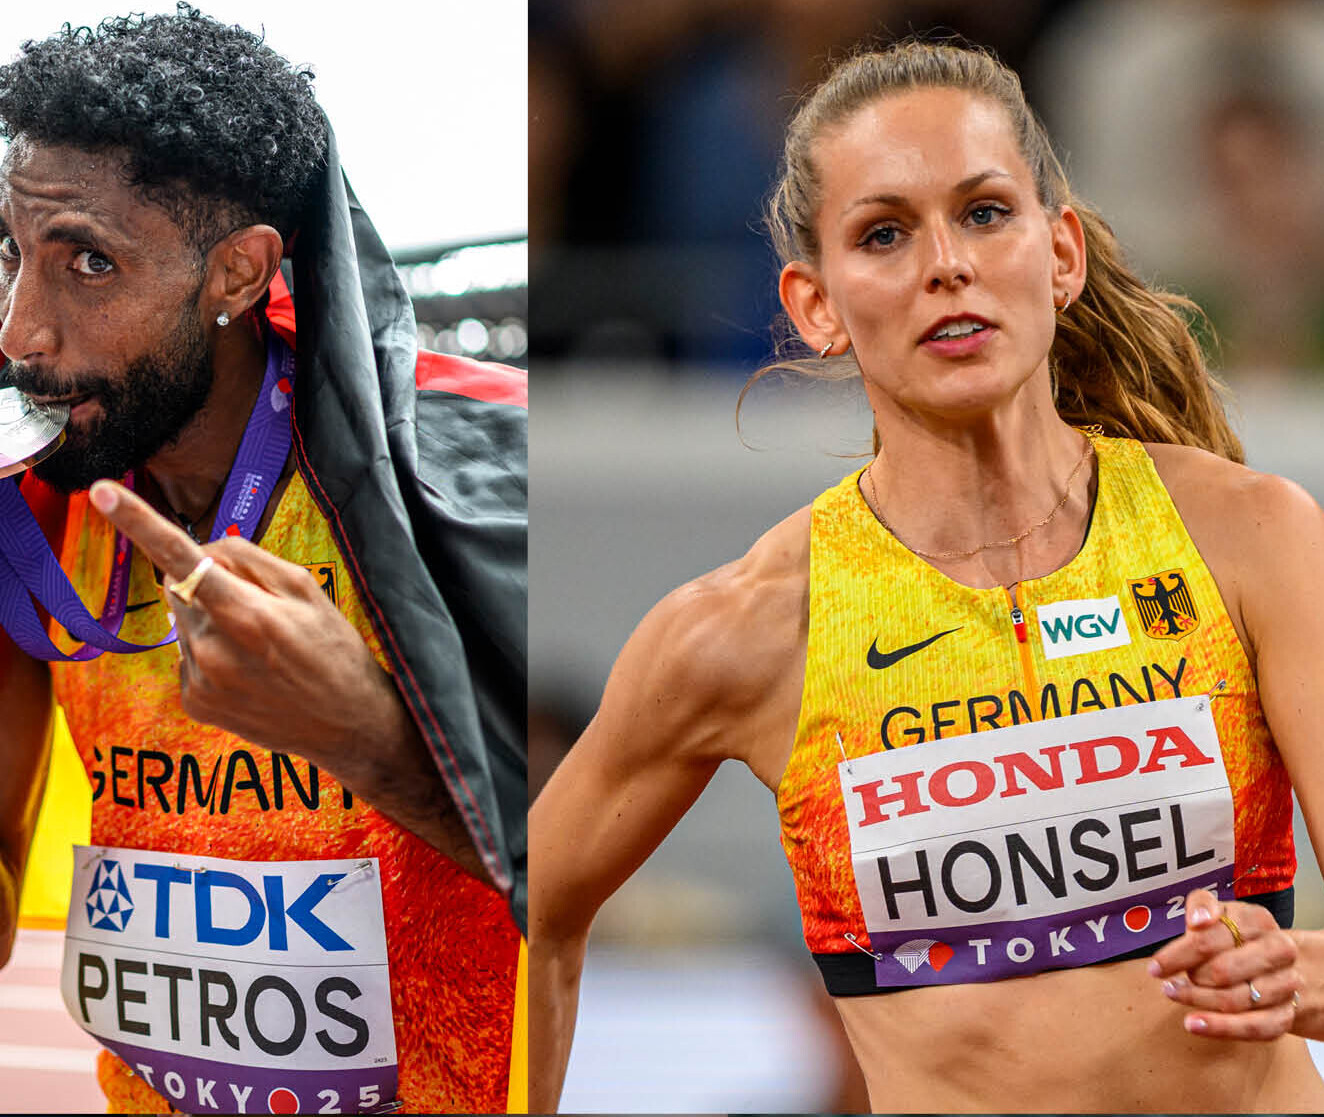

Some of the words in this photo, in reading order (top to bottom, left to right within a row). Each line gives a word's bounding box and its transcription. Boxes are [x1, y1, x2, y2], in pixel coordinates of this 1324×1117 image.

[1041, 607, 1121, 644] WGV
[880, 656, 1188, 750] GERMANY
[92, 745, 353, 815] ERMAN
[852, 725, 1215, 828] HONDA
[135, 863, 356, 952] TDK
[877, 804, 1216, 920] HONSEL
[78, 952, 370, 1058] PETROS
